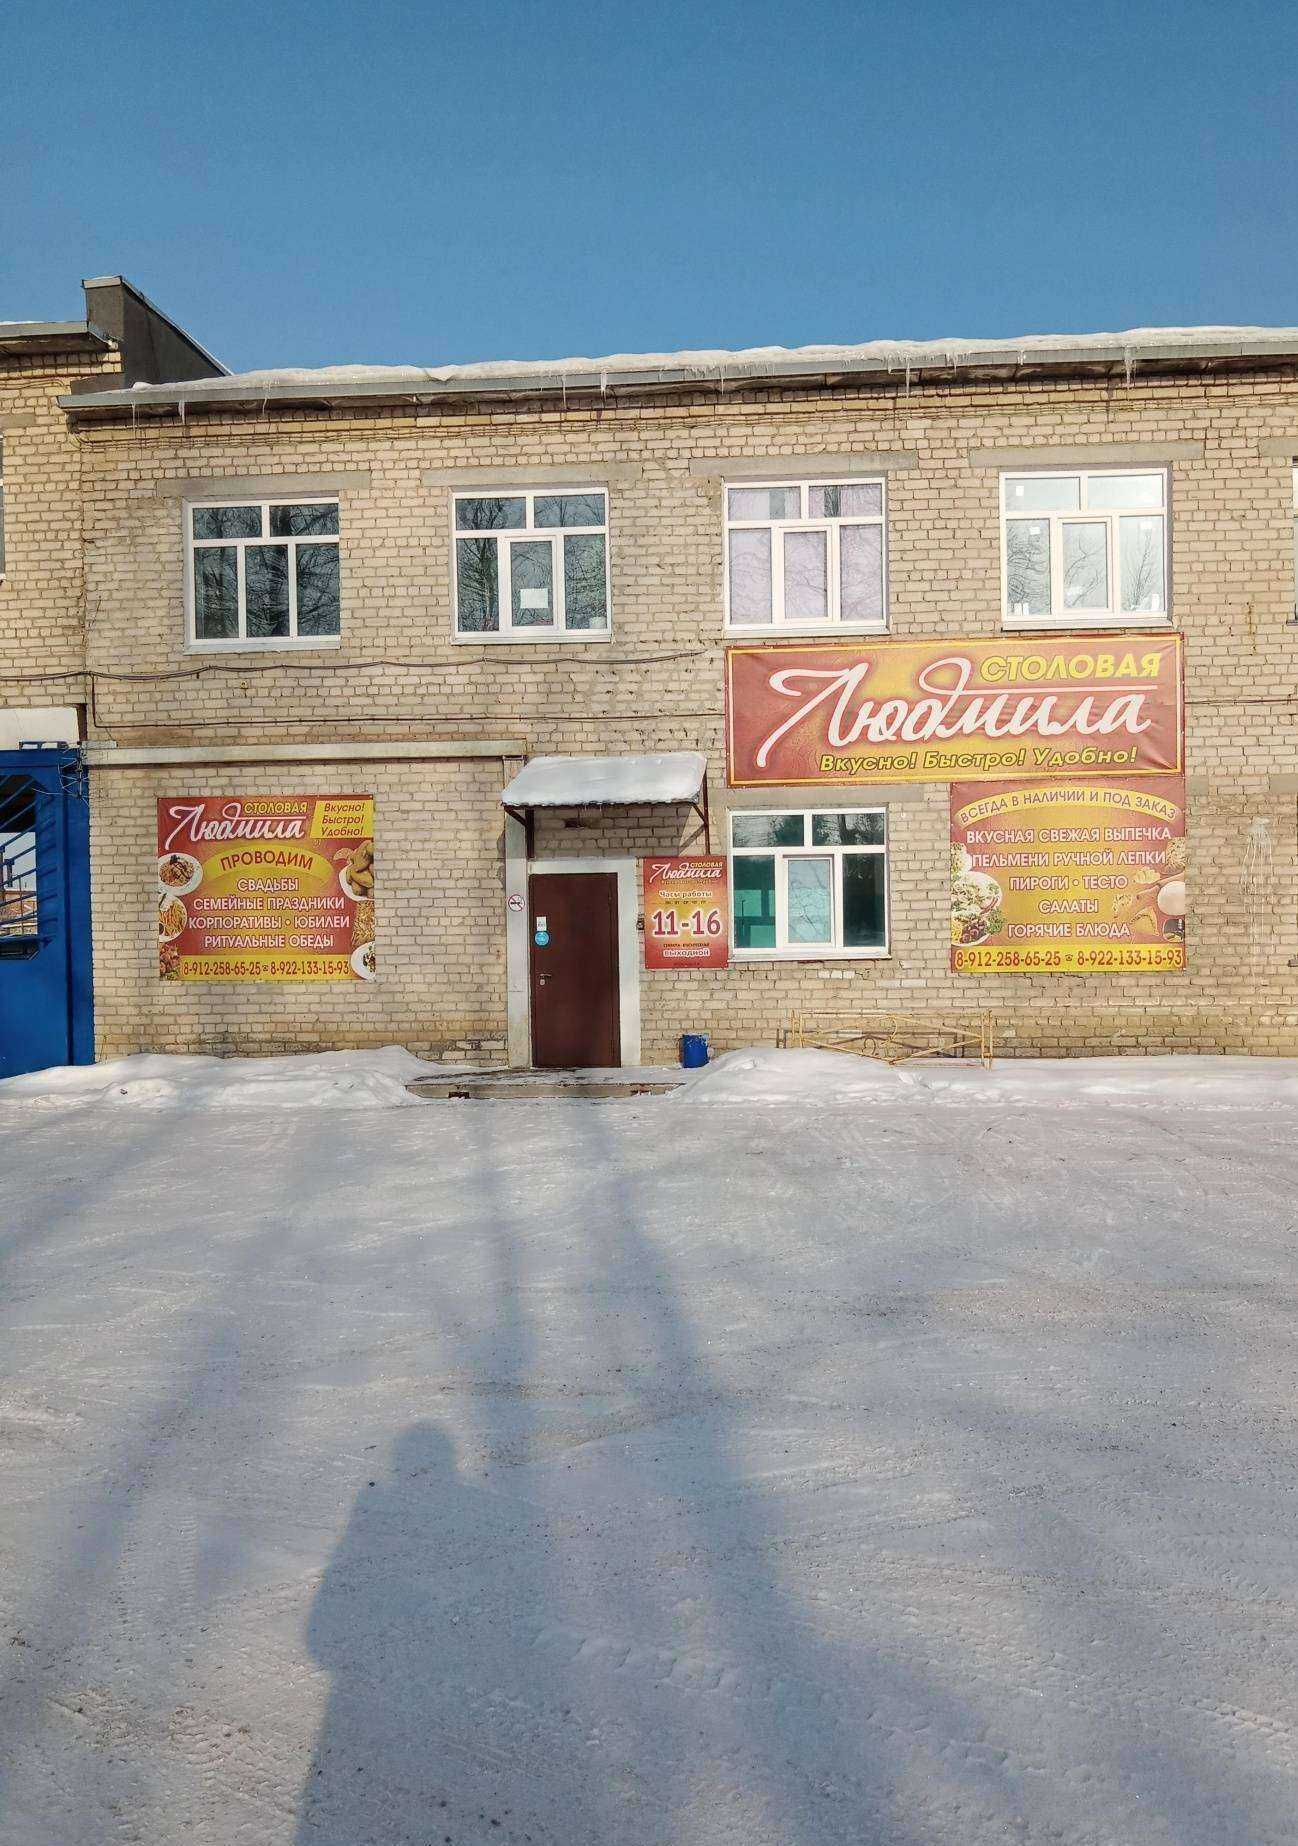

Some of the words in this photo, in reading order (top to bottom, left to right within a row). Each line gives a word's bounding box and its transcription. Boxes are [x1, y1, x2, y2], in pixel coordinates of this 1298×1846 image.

[979, 652, 1162, 682] СТОЛОВАЯ
[756, 657, 1158, 768] Людмила
[820, 751, 916, 776] Вкусно!
[923, 748, 1026, 772] Быстро!
[1034, 746, 1137, 767] Удобно!
[243, 802, 308, 814] СТОЛОВАЯ
[324, 803, 364, 812] Вкусно!
[960, 799, 1008, 824] ВСЕГДА
[1012, 796, 1019, 806] В
[1023, 790, 1085, 804] НАЛИЧИИ
[1089, 790, 1098, 801] И
[1103, 792, 1131, 807] ПОД
[1135, 796, 1177, 819] ЗАКАЗ
[164, 802, 306, 850] Людмила
[322, 815, 364, 825] Быстро!
[321, 827, 363, 837] Удобно!
[966, 829, 1034, 844] ВКУСНАЯ
[1039, 828, 1099, 843] СВЕЖАЯ
[1104, 827, 1172, 841] ВЫПЕЧКА
[220, 851, 313, 871] ПРОВОДИМ
[972, 853, 1049, 867] ПЕЛЬМЕНИ
[1053, 848, 1113, 866] РУЧНОЙ
[1117, 851, 1166, 865] ЛЕПКИ
[237, 878, 299, 893] СВАДЬБЫ
[1009, 876, 1069, 891] ПИРОГИ
[1083, 875, 1128, 889] ТЕСТО
[193, 895, 264, 910] СЕМЕЙНЫЕ
[267, 897, 345, 911] ПРАЗДНИКИ
[1039, 899, 1099, 914] САЛАТЫ
[188, 916, 282, 929] КОРПОРАТИВЫ
[294, 916, 350, 928] ЮБИЛЕИ
[653, 909, 721, 936] 11-16
[1008, 923, 1072, 938] ГОРЯЧИЕ
[1076, 923, 1131, 939] БЛЮДА
[204, 935, 285, 948] РИТУАЛЬНЫЕ
[289, 935, 334, 949] ОБЕДЫ
[956, 952, 1061, 968] 8-912-258-65-25
[1077, 950, 1183, 966] 8-922-133-15-93
[183, 961, 261, 976] 8-912-258-65-25
[270, 960, 349, 975] 8-922-133-15-93
